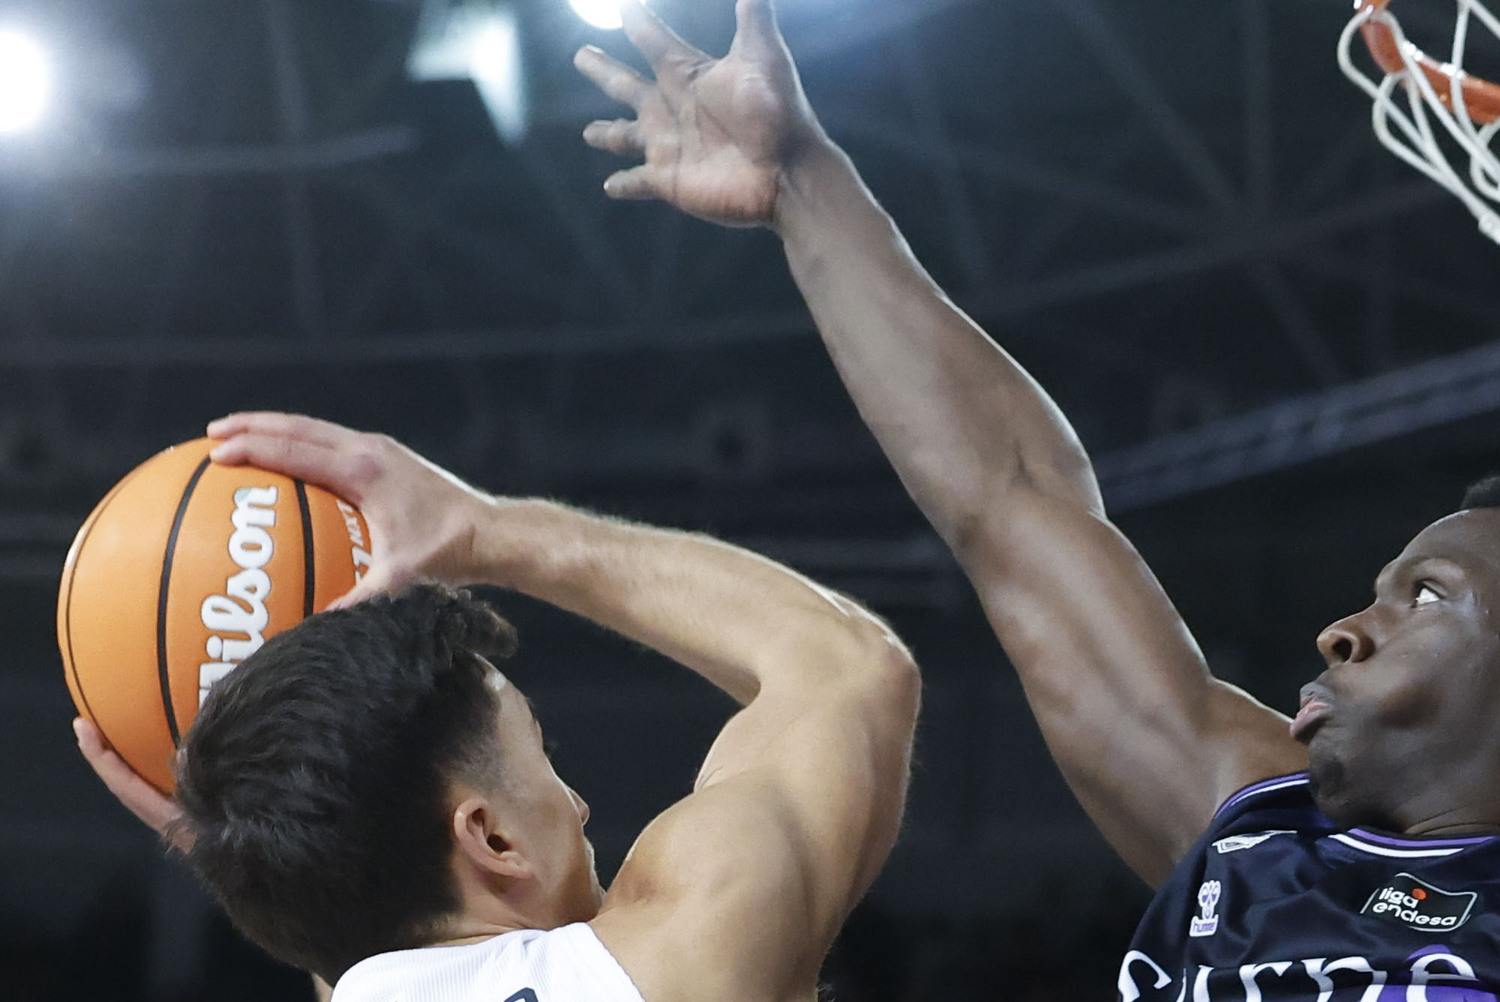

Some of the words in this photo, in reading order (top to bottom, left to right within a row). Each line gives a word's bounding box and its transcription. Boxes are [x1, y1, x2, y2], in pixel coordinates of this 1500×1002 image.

[199, 486, 278, 708] ilson
[1378, 887, 1419, 908] liga
[1372, 902, 1457, 926] endesa
